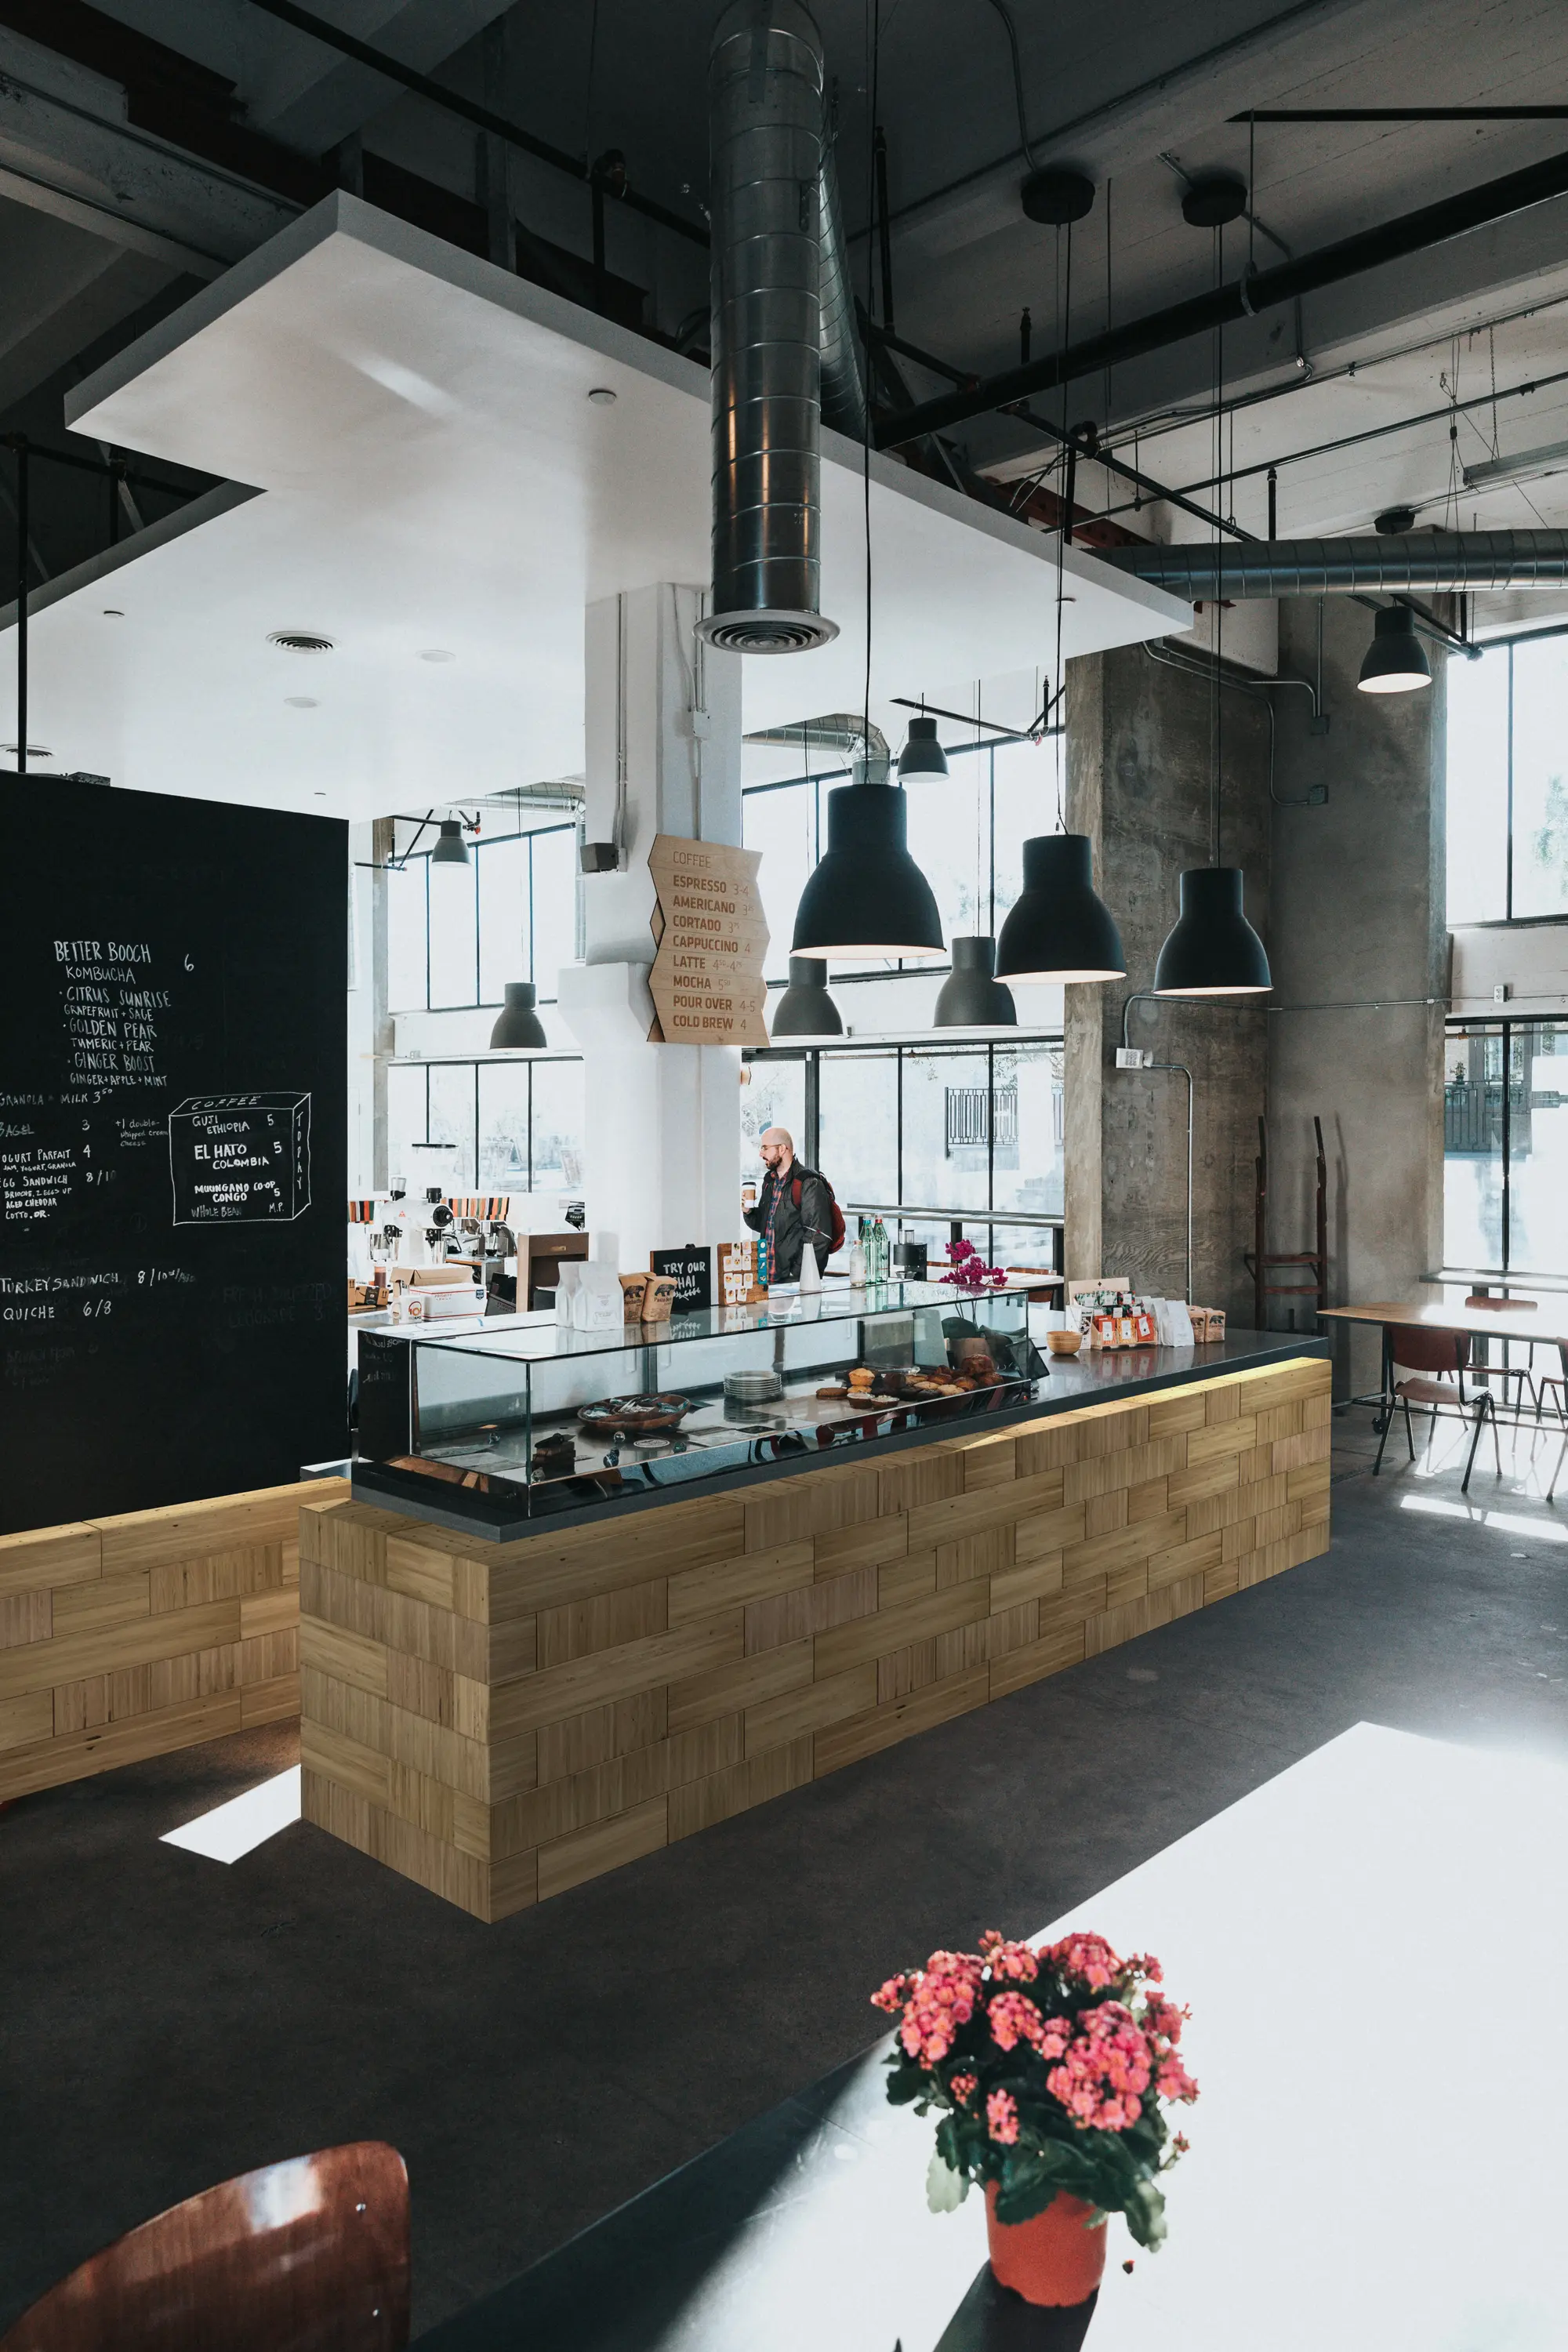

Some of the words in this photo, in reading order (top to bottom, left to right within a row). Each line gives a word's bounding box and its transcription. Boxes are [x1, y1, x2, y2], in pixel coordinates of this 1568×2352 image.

[673, 851, 712, 869] COFFEE
[673, 875, 727, 894] ESPRESSO
[734, 883, 750, 896] 3-4
[673, 895, 735, 914] AMERICANO
[673, 914, 721, 932] CORTADO
[673, 935, 739, 953] CAPPUCCINO
[745, 944, 750, 953] 4
[53, 941, 102, 962] BETTER
[108, 942, 151, 963] BOOCH
[183, 953, 194, 971] 6
[673, 954, 706, 970] LATTE
[66, 965, 136, 985] KOMBUCHA
[673, 975, 712, 989] MOCHA
[67, 986, 110, 1004] CITRUS
[119, 989, 172, 1008] SUNRISE
[673, 995, 702, 1009] POUR
[705, 997, 732, 1011] OVER
[739, 1000, 755, 1013] 4-5
[64, 1005, 119, 1019] GRAPEFRUIT
[129, 1008, 154, 1022] SAGE
[70, 1018, 118, 1036] GOLDEN
[124, 1022, 158, 1040] PEAR
[673, 1014, 699, 1028] COLD
[702, 1015, 734, 1030] BREW
[740, 1018, 747, 1030] 4
[71, 1038, 118, 1051] TUMERIC
[126, 1040, 154, 1052] PEAR
[74, 1052, 119, 1071] GINGER
[124, 1054, 154, 1073] BOOST
[110, 1075, 136, 1086] APPLE
[144, 1075, 168, 1087] MINT
[0, 1092, 44, 1107] GRANOLA
[60, 1093, 89, 1104] MILK
[191, 1095, 262, 1111] COFFEE
[82, 1119, 91, 1131] 3
[192, 1115, 219, 1127] GUJI
[267, 1113, 274, 1127] 5
[207, 1121, 251, 1135] ETHIOPIA
[0, 1152, 31, 1163] OGURT
[38, 1149, 71, 1161] PARFAIT
[82, 1144, 91, 1159] 4
[194, 1145, 211, 1160] EL
[214, 1143, 248, 1159] HATO
[273, 1142, 282, 1154] 5
[212, 1156, 270, 1170] COLOMBIA
[23, 1174, 67, 1187] SANDWICH
[212, 1192, 248, 1203] CONGO
[274, 1189, 281, 1198] 5
[6, 1200, 24, 1209] AGED
[25, 1197, 57, 1207] CHEDDAR
[191, 1205, 220, 1218] WHOLE
[221, 1206, 241, 1218] BEAN
[663, 1262, 684, 1275] TRY
[688, 1261, 706, 1273] OUR
[0, 1276, 50, 1294] TURKEY
[52, 1272, 119, 1291] SANDWICH
[674, 1275, 695, 1290] HAI
[3, 1305, 55, 1320] QUICHE
